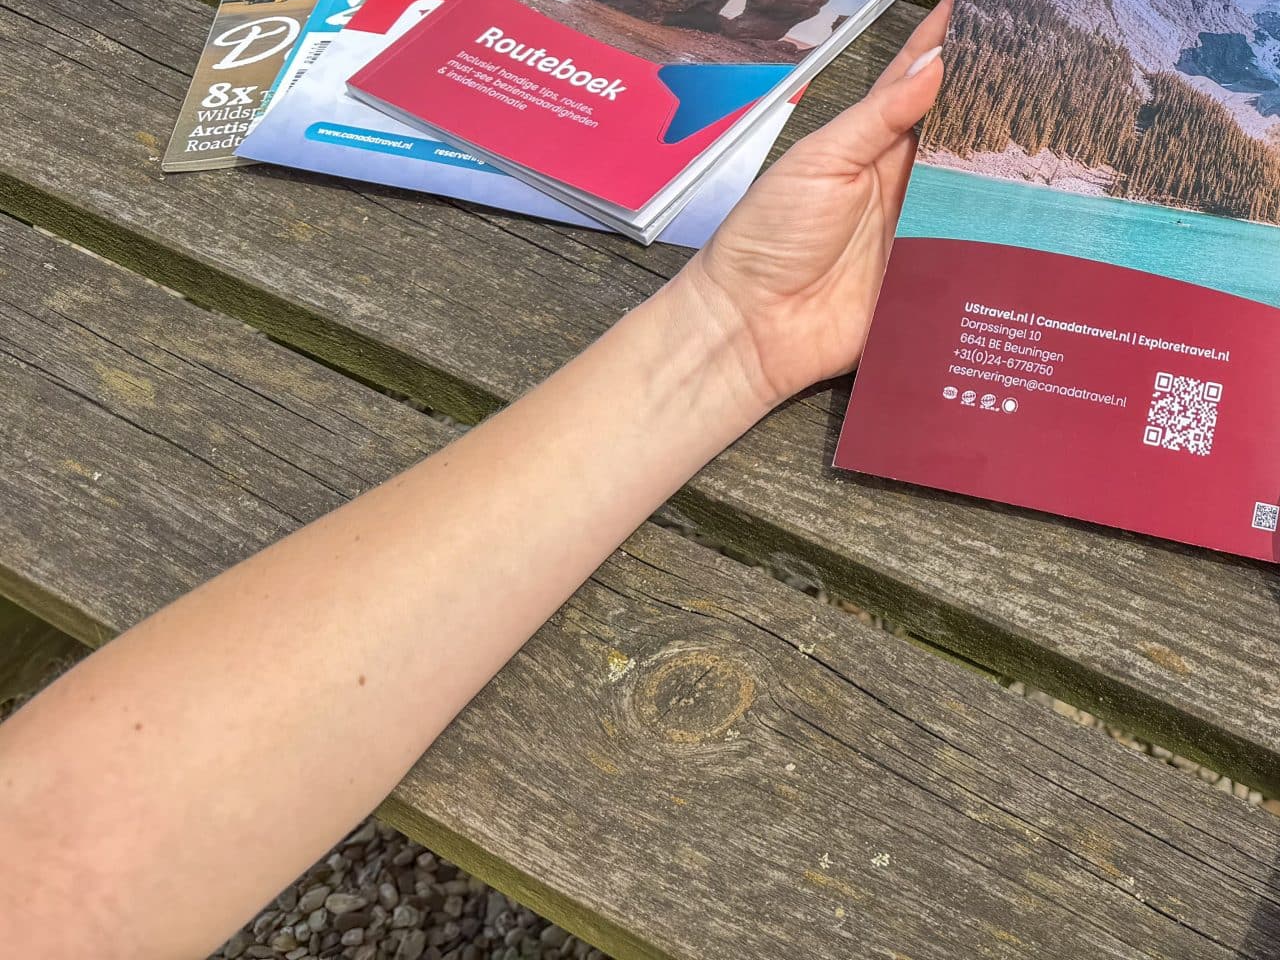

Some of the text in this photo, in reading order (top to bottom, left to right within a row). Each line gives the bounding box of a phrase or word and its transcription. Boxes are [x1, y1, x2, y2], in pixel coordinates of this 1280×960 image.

[456, 50, 501, 74] Inclusief
[498, 68, 540, 92] handige
[474, 26, 627, 101] Routeboek
[201, 82, 259, 108] 8x
[437, 66, 528, 111] & insiderinformatie
[447, 59, 600, 129] must-see bezienswaardigheden
[317, 127, 415, 151] www.canadatravel.nl
[960, 317, 1042, 342] Dorpssingel 10
[960, 332, 1064, 362] 6641 BE Beuningen
[964, 301, 1028, 323] UStravel.nl
[1036, 316, 1131, 343] Canadatravel.nl
[1138, 334, 1230, 362] Exploretravel.nl
[953, 348, 1054, 376] +31(0)24-6778750
[948, 364, 1127, 408] reserveringen@canadatravel.nl
